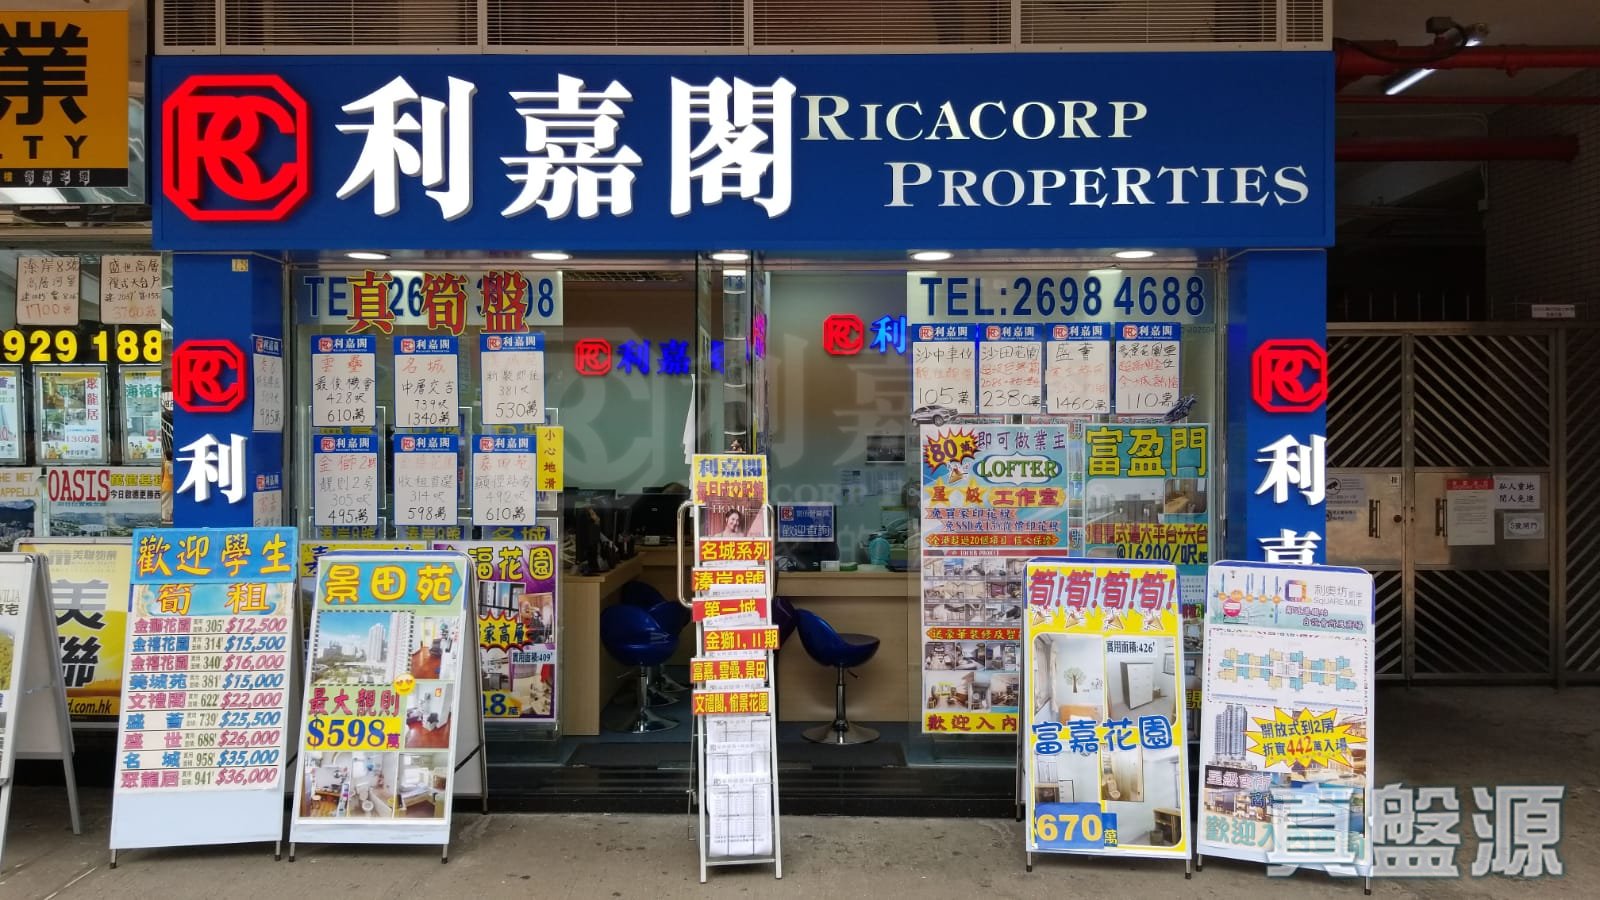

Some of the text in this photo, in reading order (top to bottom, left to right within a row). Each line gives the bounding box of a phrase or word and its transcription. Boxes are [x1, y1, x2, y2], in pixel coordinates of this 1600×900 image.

[800, 95, 1147, 141] RICACORP
[0, 135, 88, 159] TY
[336, 74, 797, 220] 利嘉閣
[884, 161, 1309, 208] PROPERTIES
[347, 270, 529, 335] 真筍盤
[920, 276, 1205, 316] TEL:2698 4688
[977, 429, 1066, 450] 即可做業主
[1086, 427, 1207, 477] 富盈門
[176, 433, 248, 504] 利
[979, 460, 1058, 478] LOFTER
[48, 470, 110, 502] OASIS
[137, 533, 291, 577] 歡迎學生
[702, 541, 770, 560] 名城系列
[447, 545, 555, 581] 福花園
[324, 564, 455, 605] 景田苑
[225, 617, 288, 634] $12,500
[224, 636, 286, 652] $15,500
[223, 655, 285, 671] $16,000
[223, 674, 284, 690] $15,000
[220, 692, 282, 709] $22,000
[219, 711, 281, 728] $25,500
[217, 730, 280, 748] $26,000
[1032, 715, 1173, 755] 富嘉花園
[216, 750, 279, 767] $35,000
[215, 768, 278, 786] $36,000
